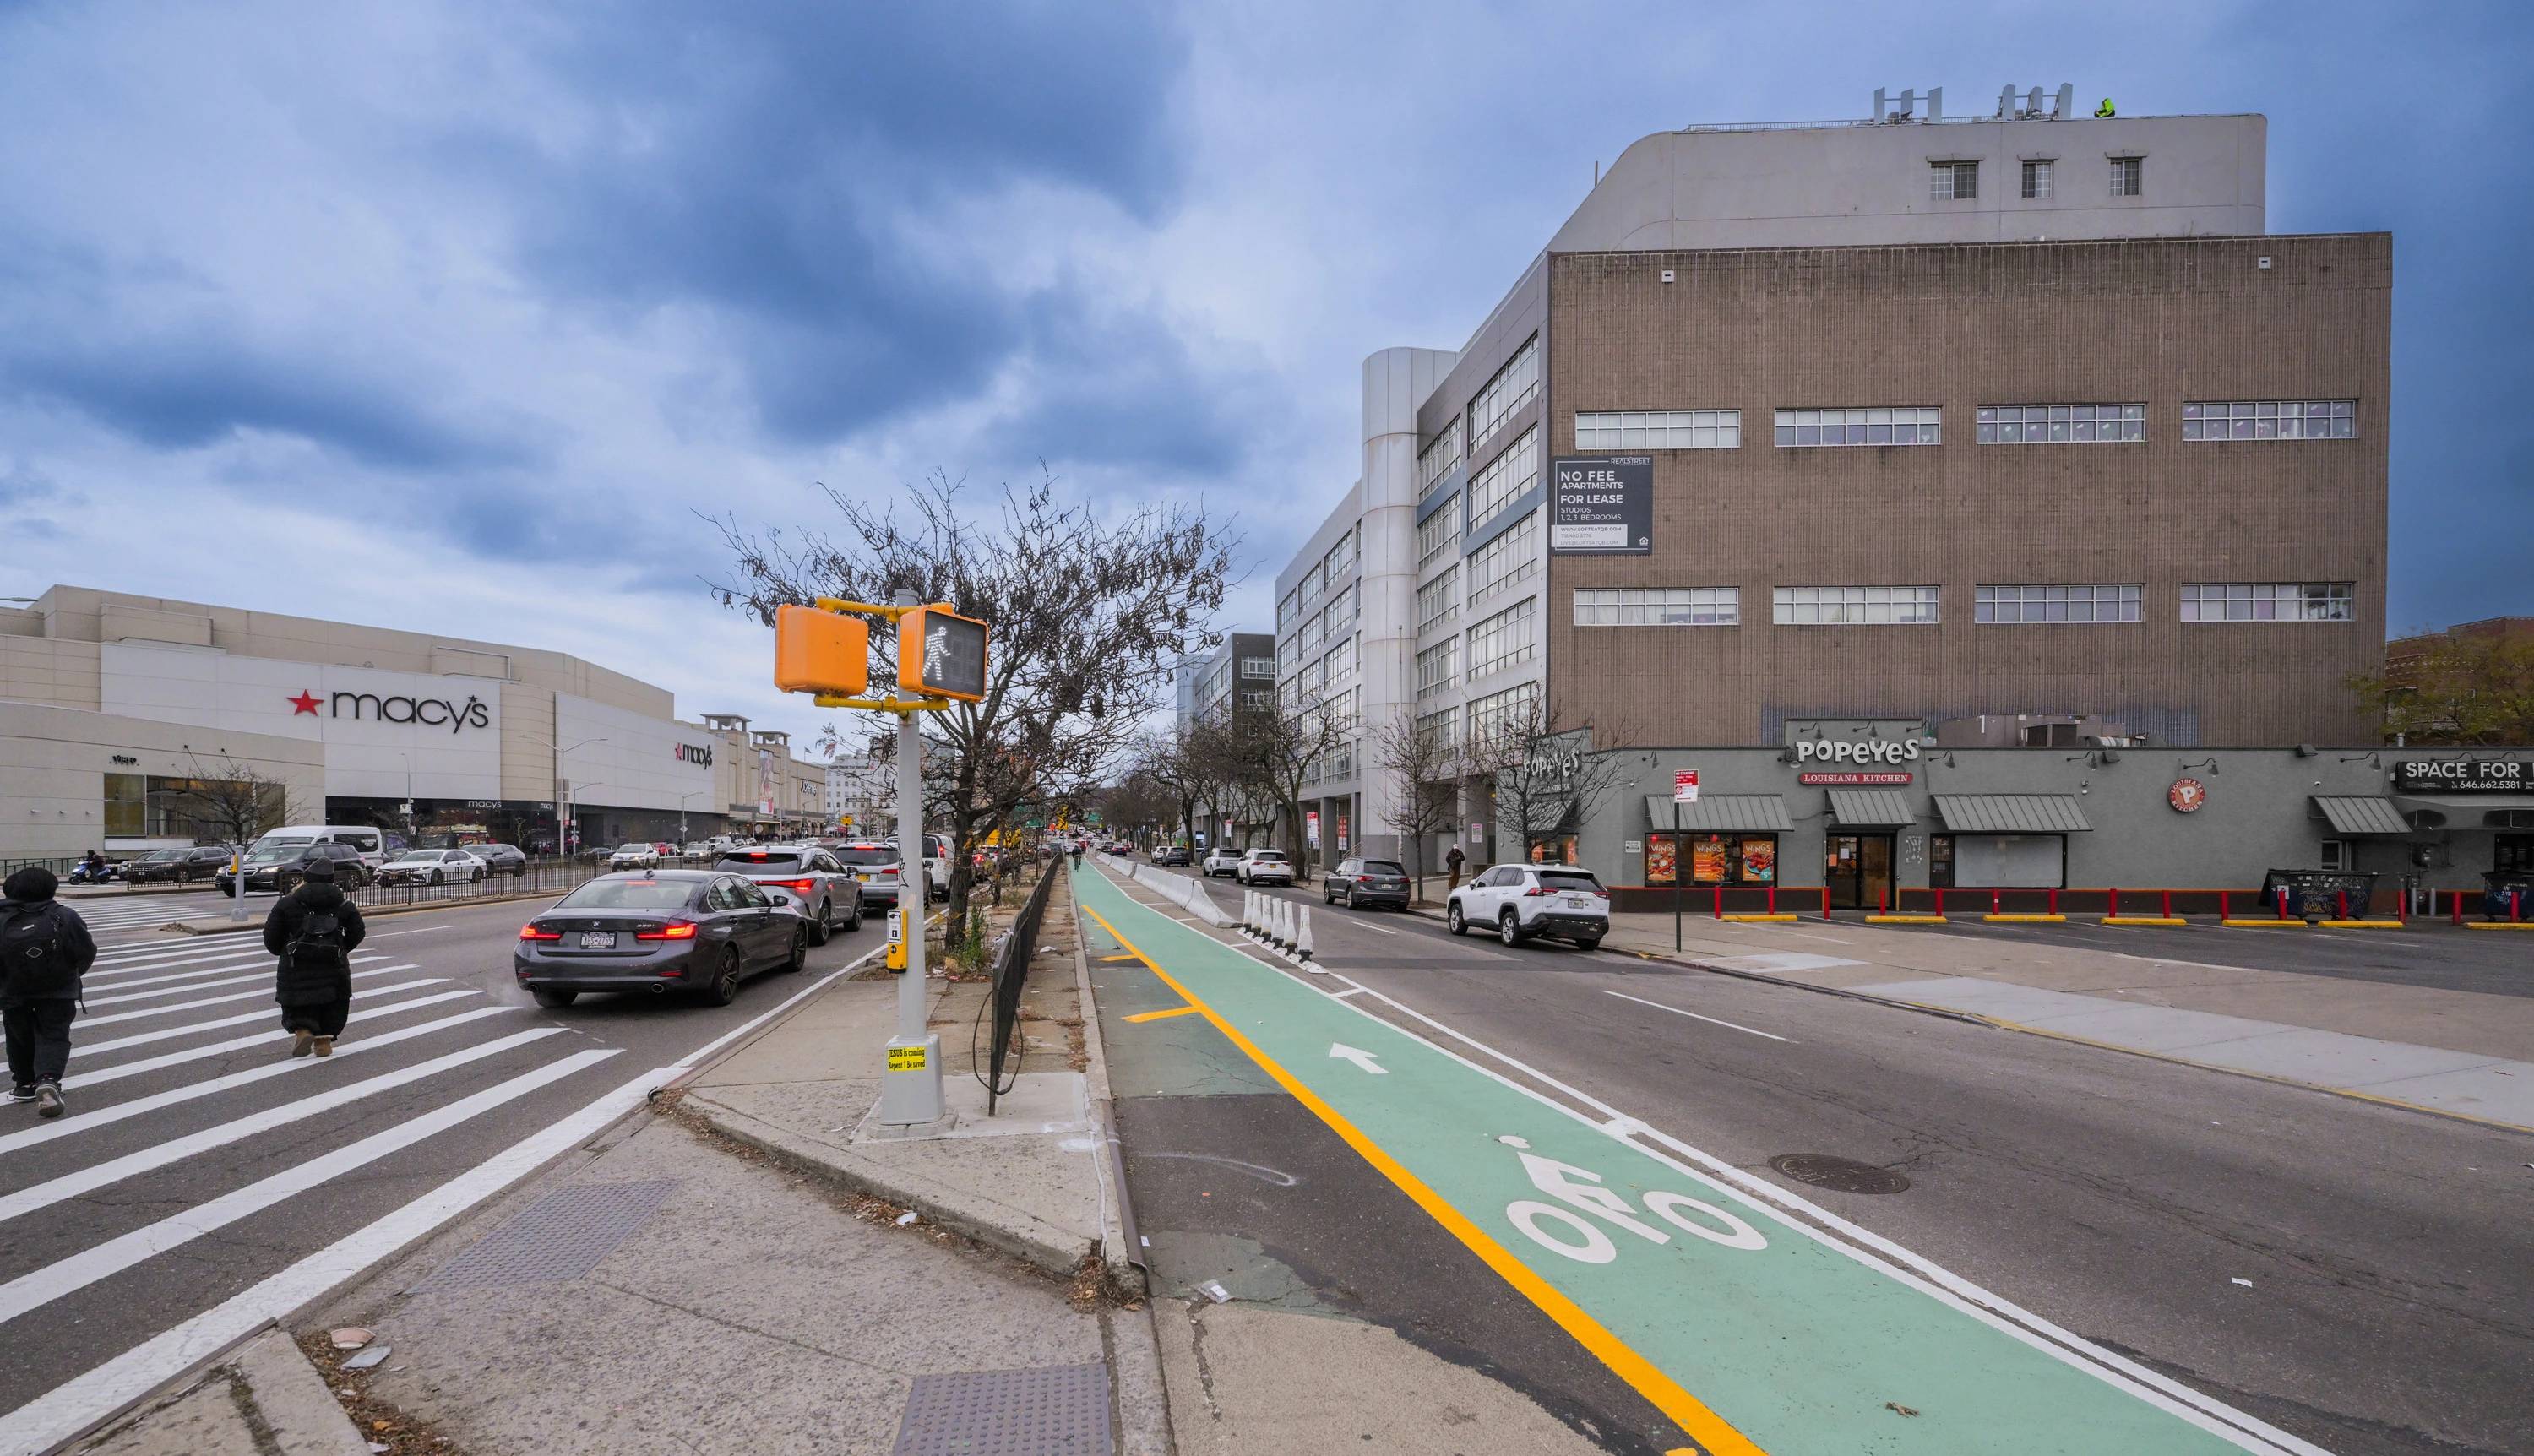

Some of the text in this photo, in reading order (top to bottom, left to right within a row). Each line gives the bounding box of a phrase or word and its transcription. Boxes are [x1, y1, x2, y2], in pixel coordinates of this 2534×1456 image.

[1561, 470, 1615, 481] NO FEE
[1561, 481, 1623, 490] APARTMENTS
[1561, 494, 1623, 503] FOR LEASE
[332, 692, 489, 734] macy's
[2406, 762, 2467, 778] SPACE
[2480, 762, 2520, 778] FOR
[2459, 780, 2520, 790] 646.662.5381
[889, 1048, 925, 1059] JESUS is coming
[913, 1059, 926, 1068] saved
